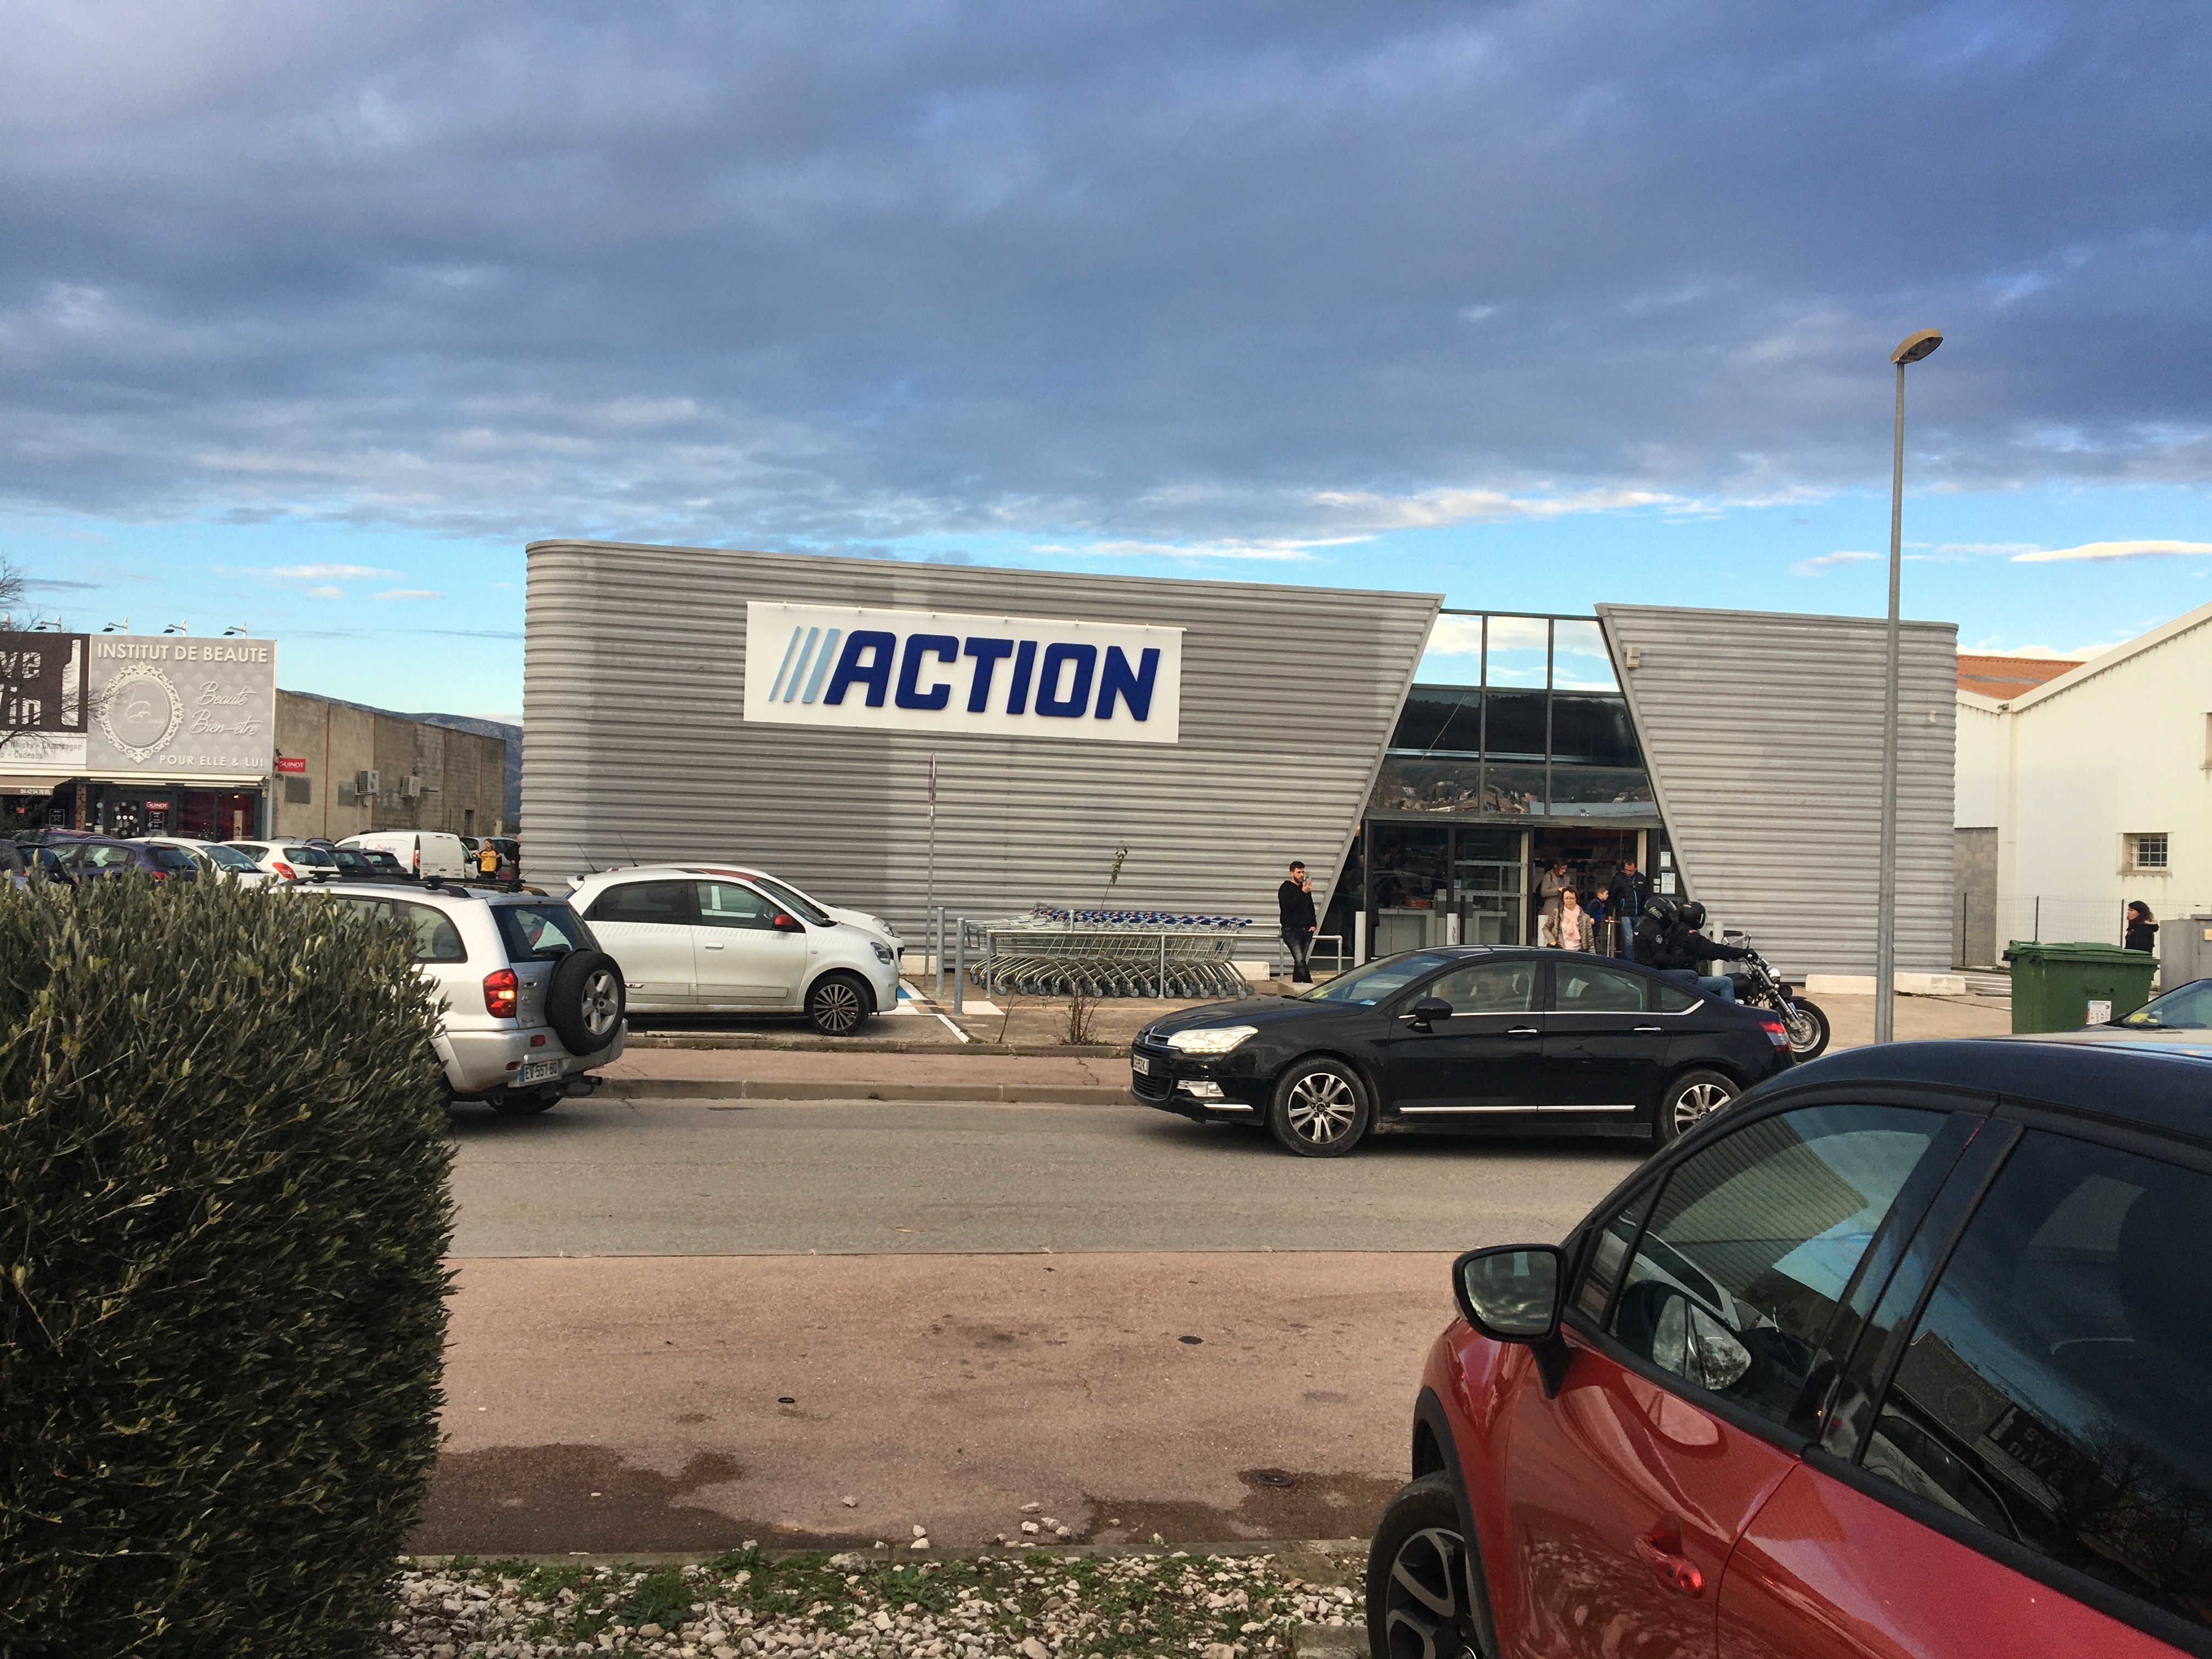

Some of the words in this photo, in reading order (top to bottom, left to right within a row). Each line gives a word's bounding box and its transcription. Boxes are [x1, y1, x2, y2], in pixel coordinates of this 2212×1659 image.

[98, 644, 169, 659] INSTITUT
[174, 645, 197, 660] DE
[204, 646, 267, 662] BEAUTE
[823, 630, 1161, 721] ACTION
[0, 684, 41, 725] in
[196, 681, 257, 706] Beauté
[189, 709, 263, 735] Bien-être
[14, 750, 43, 759] Cadeaux
[160, 755, 194, 765] POUR
[200, 756, 226, 766] ELLE
[232, 758, 239, 766] &
[246, 757, 263, 767] LUI
